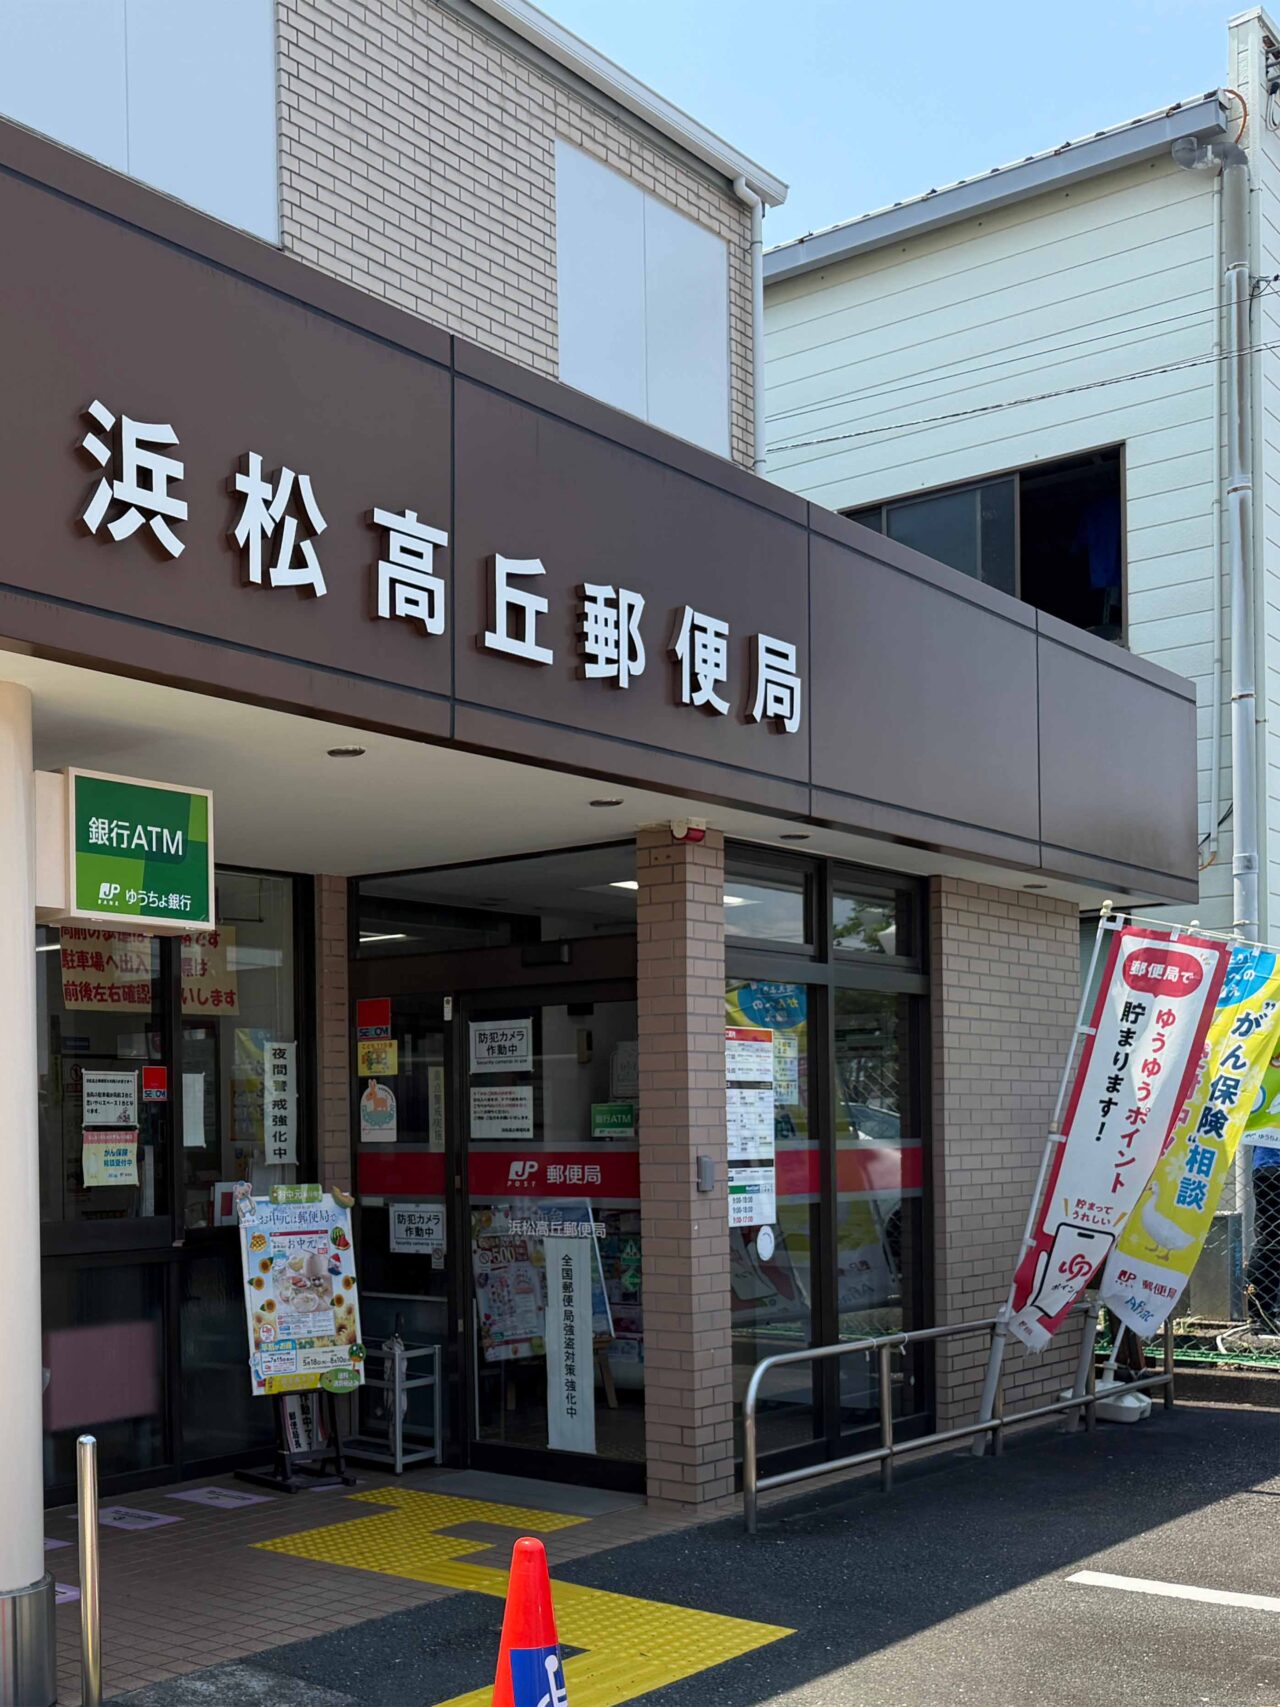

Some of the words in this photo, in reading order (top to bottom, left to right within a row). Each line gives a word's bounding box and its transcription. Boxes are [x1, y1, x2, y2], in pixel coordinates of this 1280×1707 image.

[81, 400, 802, 733] 浜松高丘郵便局
[88, 817, 183, 856] 銀行ATM
[125, 888, 192, 911] ゆうちょ銀行
[1129, 960, 1194, 984] 郵便局で
[478, 1030, 525, 1044] 防犯カメラ
[487, 1043, 517, 1056] 作動中
[272, 1047, 288, 1159] 夜間警戒強化中
[1111, 1008, 1177, 1194] ゆうゆうポイント
[546, 1165, 601, 1185] 郵便局
[1075, 1198, 1114, 1215] 貯まって
[396, 1214, 441, 1225] 防犯カメラ
[1072, 1210, 1112, 1226] うれしい
[405, 1226, 434, 1238] 作動中
[507, 1220, 607, 1239] 浜松高丘郵便局
[1141, 1280, 1178, 1300] 郵便局
[1125, 1296, 1155, 1323] Aflac
